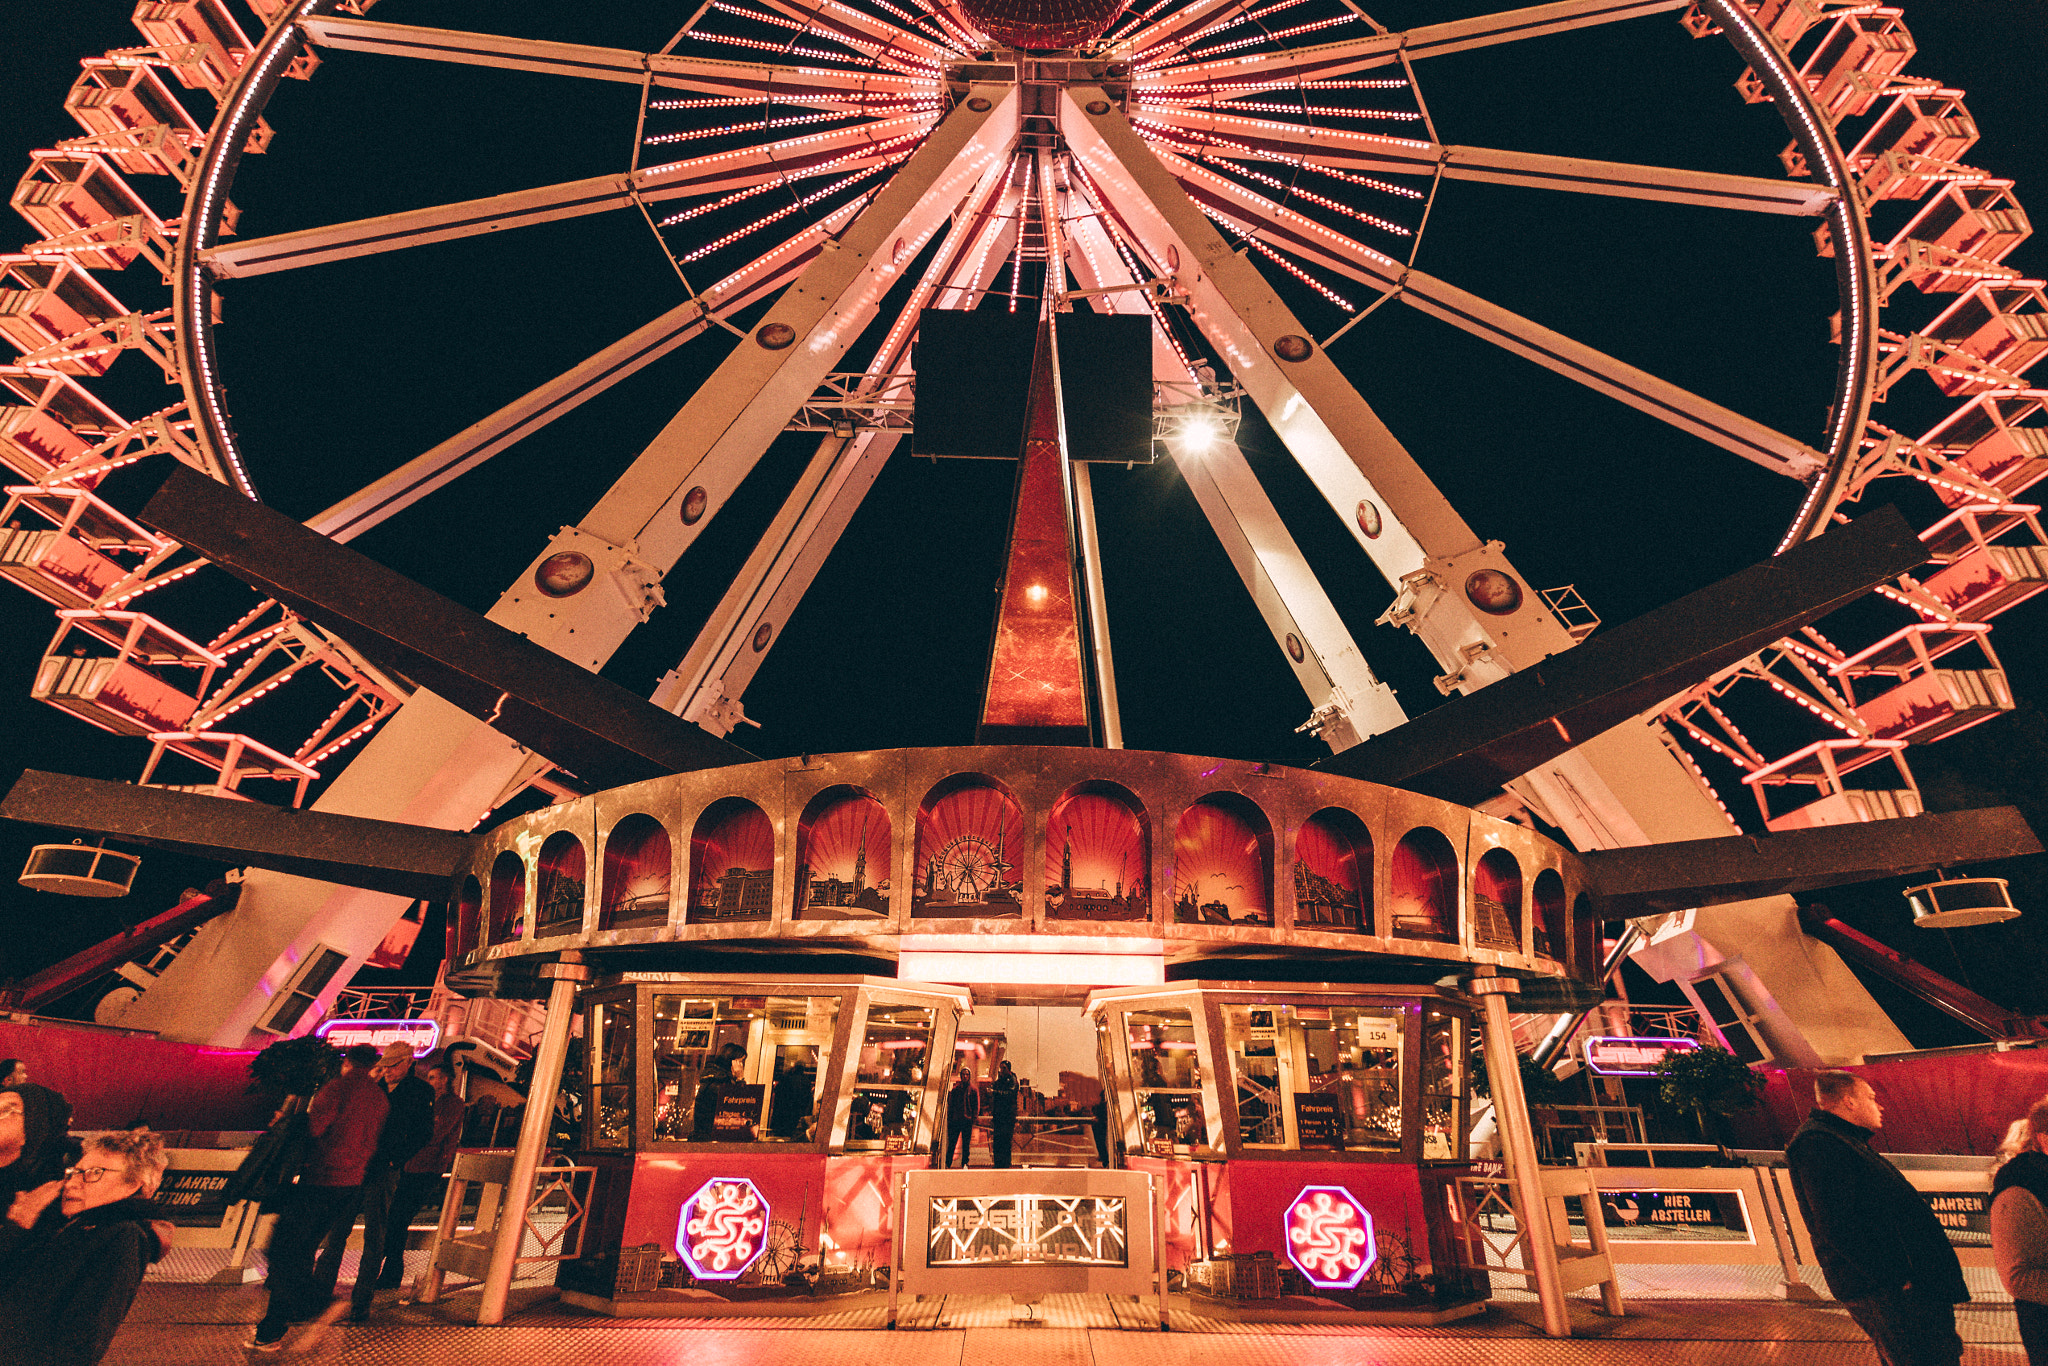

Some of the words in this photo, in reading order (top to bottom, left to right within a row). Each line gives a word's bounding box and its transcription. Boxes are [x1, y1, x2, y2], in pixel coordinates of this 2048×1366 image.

[1370, 1031, 1387, 1041] 154
[723, 1096, 756, 1105] Fahrpreis
[1301, 1104, 1334, 1114] Fahrpreis
[1483, 1162, 1503, 1175] BANK
[174, 1176, 229, 1190] JAHREN
[153, 1191, 203, 1206] EITUNG
[1663, 1195, 1692, 1208] HIER
[1930, 1197, 1983, 1211] JAHREN
[1650, 1209, 1712, 1222] ABSTELLEN
[957, 1243, 1096, 1262] HAMBUR
